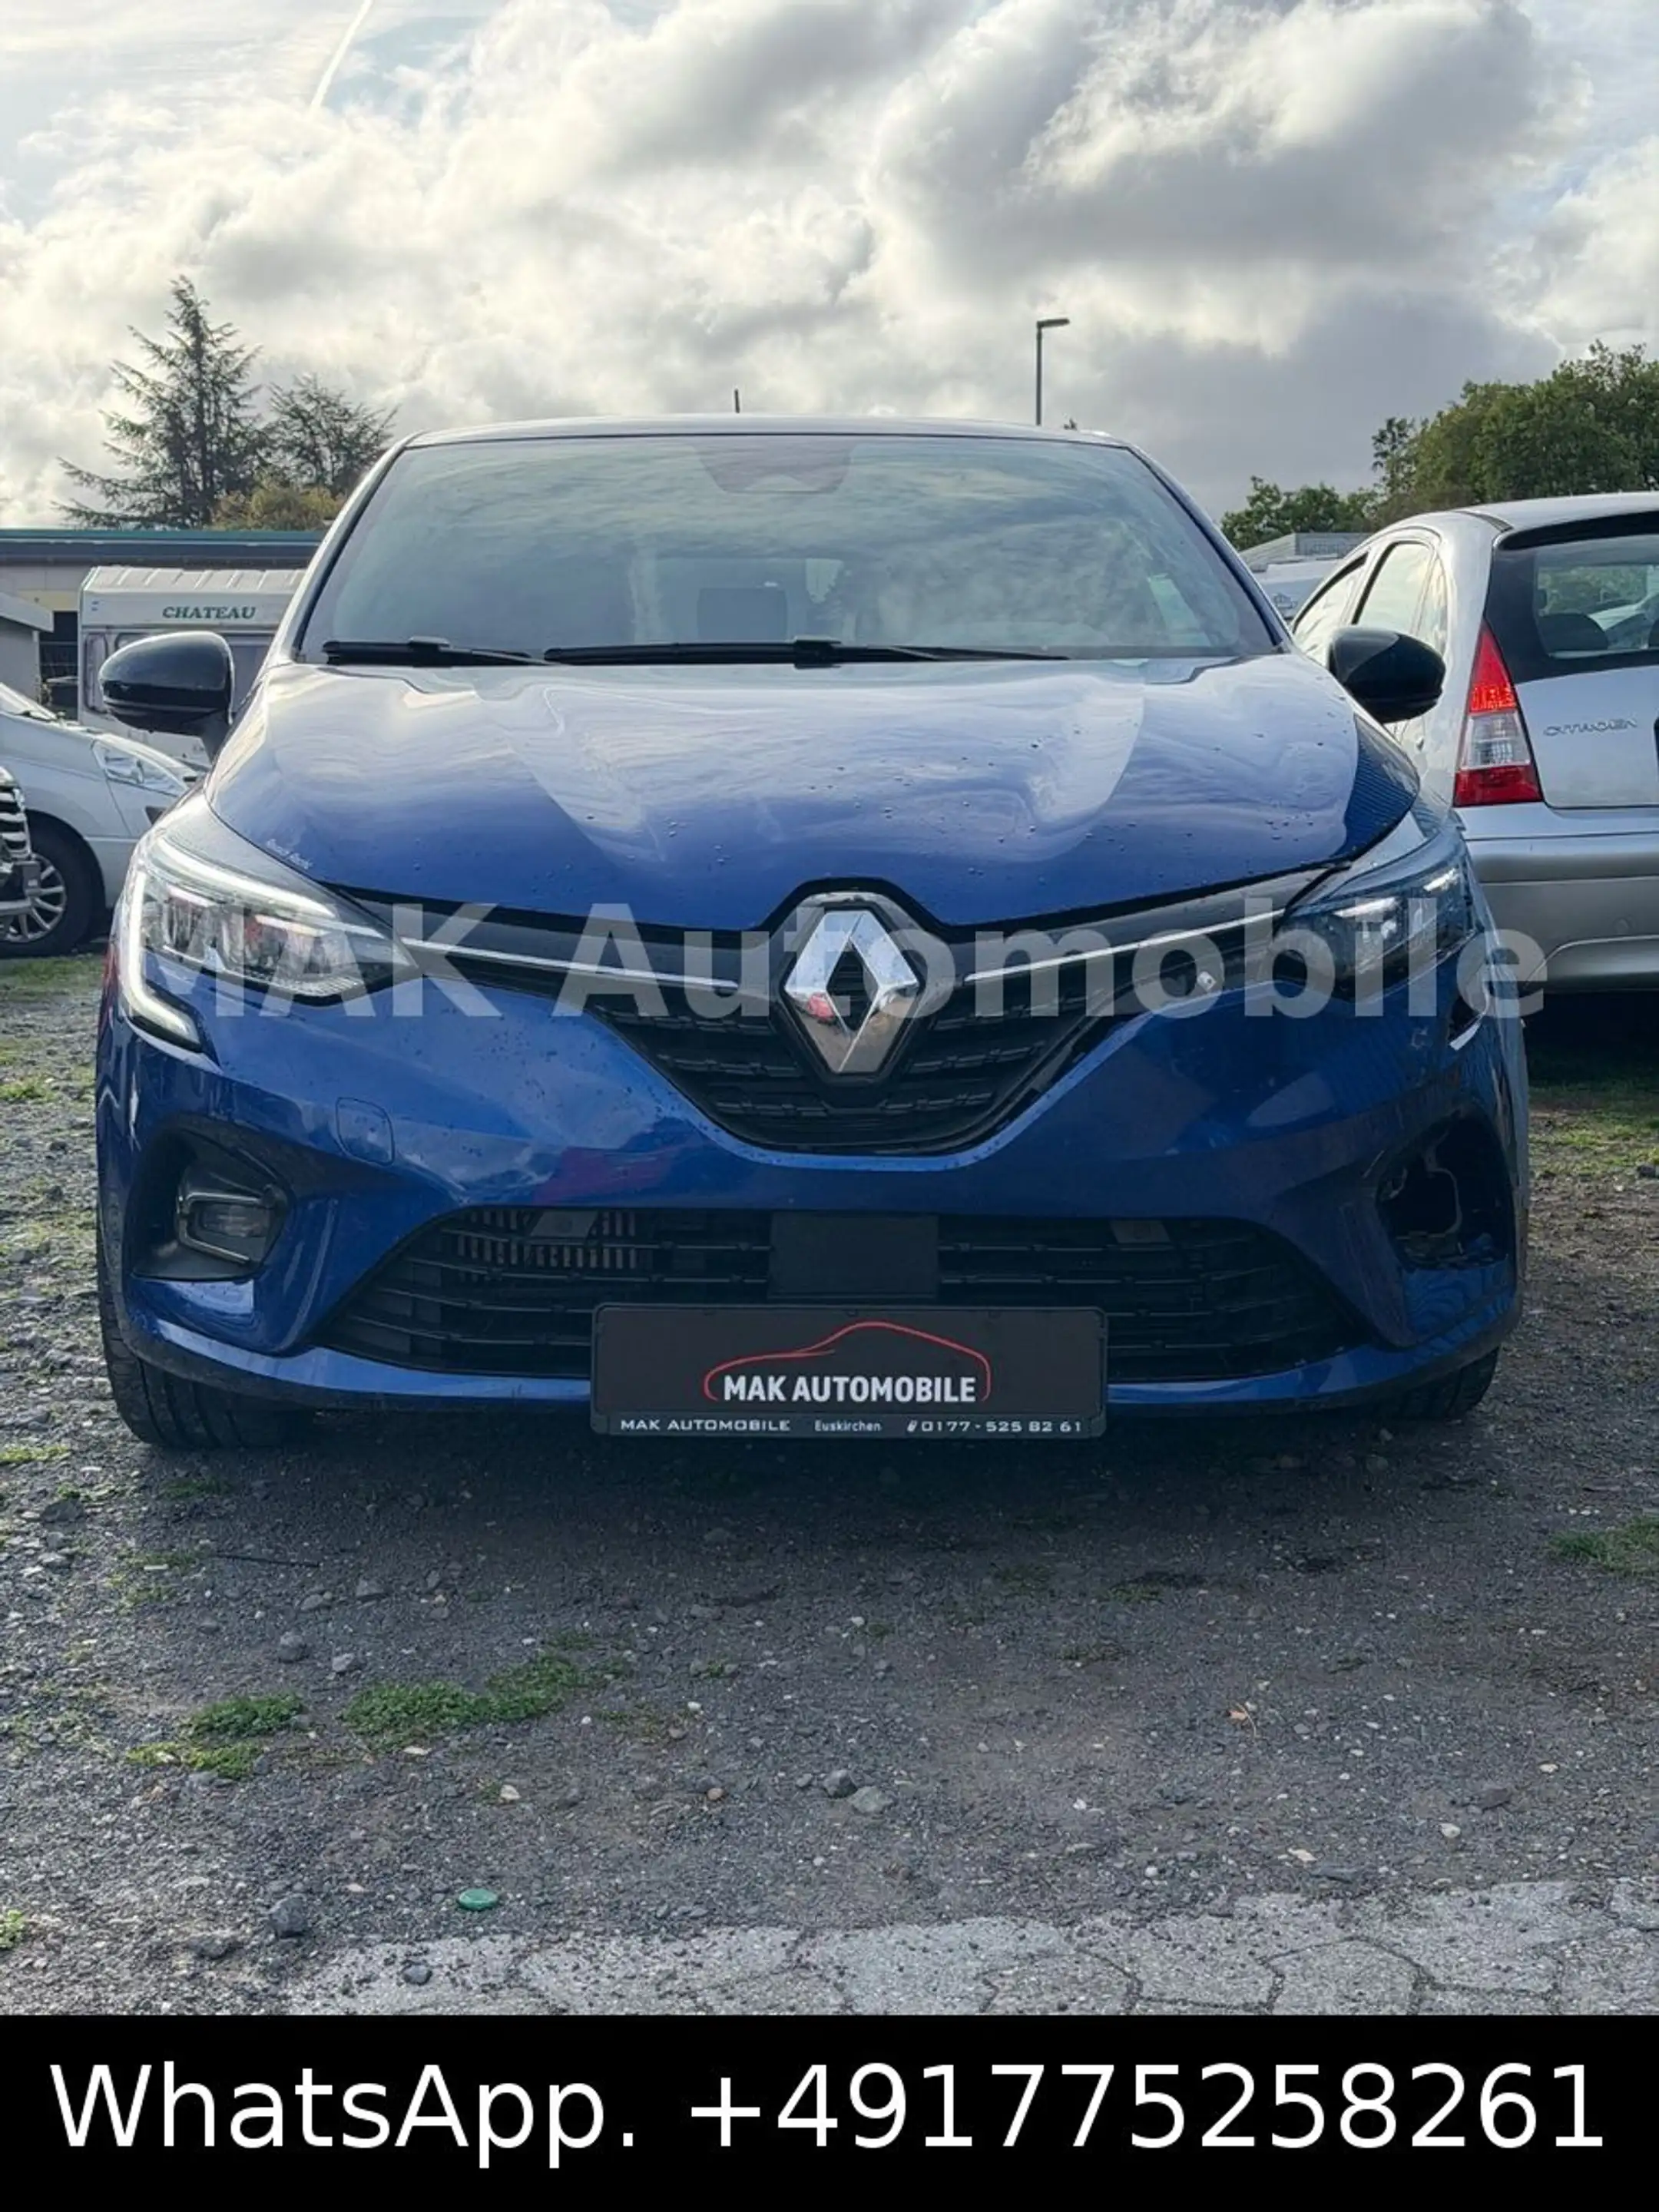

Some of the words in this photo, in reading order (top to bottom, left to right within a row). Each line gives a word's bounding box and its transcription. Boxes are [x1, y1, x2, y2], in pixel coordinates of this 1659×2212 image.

[161, 606, 257, 619] CHATEAU
[724, 1375, 786, 1402] MAK
[791, 1376, 976, 1402] AUTOMOBILE
[621, 1419, 661, 1430] MAK
[667, 1419, 790, 1431] AUTOMOBILE
[814, 1420, 882, 1432] Euskirchen
